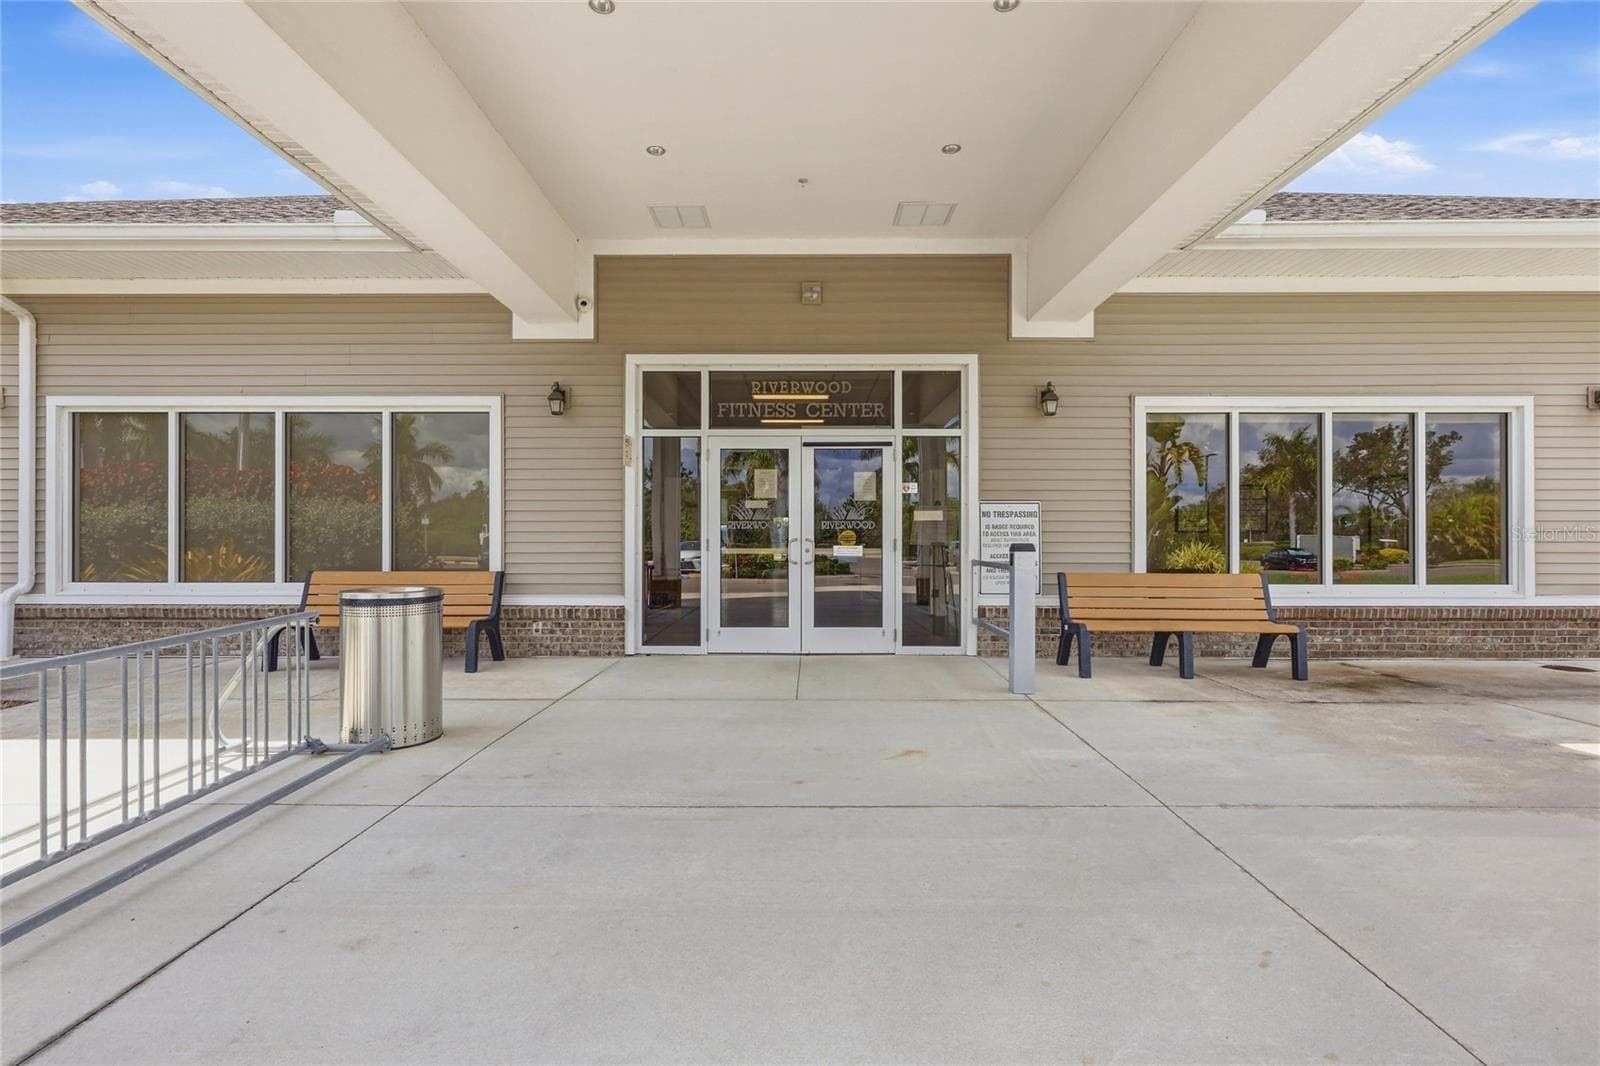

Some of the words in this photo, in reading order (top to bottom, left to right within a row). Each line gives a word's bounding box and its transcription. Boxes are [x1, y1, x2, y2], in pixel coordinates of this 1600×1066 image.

[751, 381, 853, 394] RIVERWOOD
[717, 402, 797, 418] FITNESS
[805, 402, 886, 418] CENTER
[821, 520, 876, 530] RIVERWOOD
